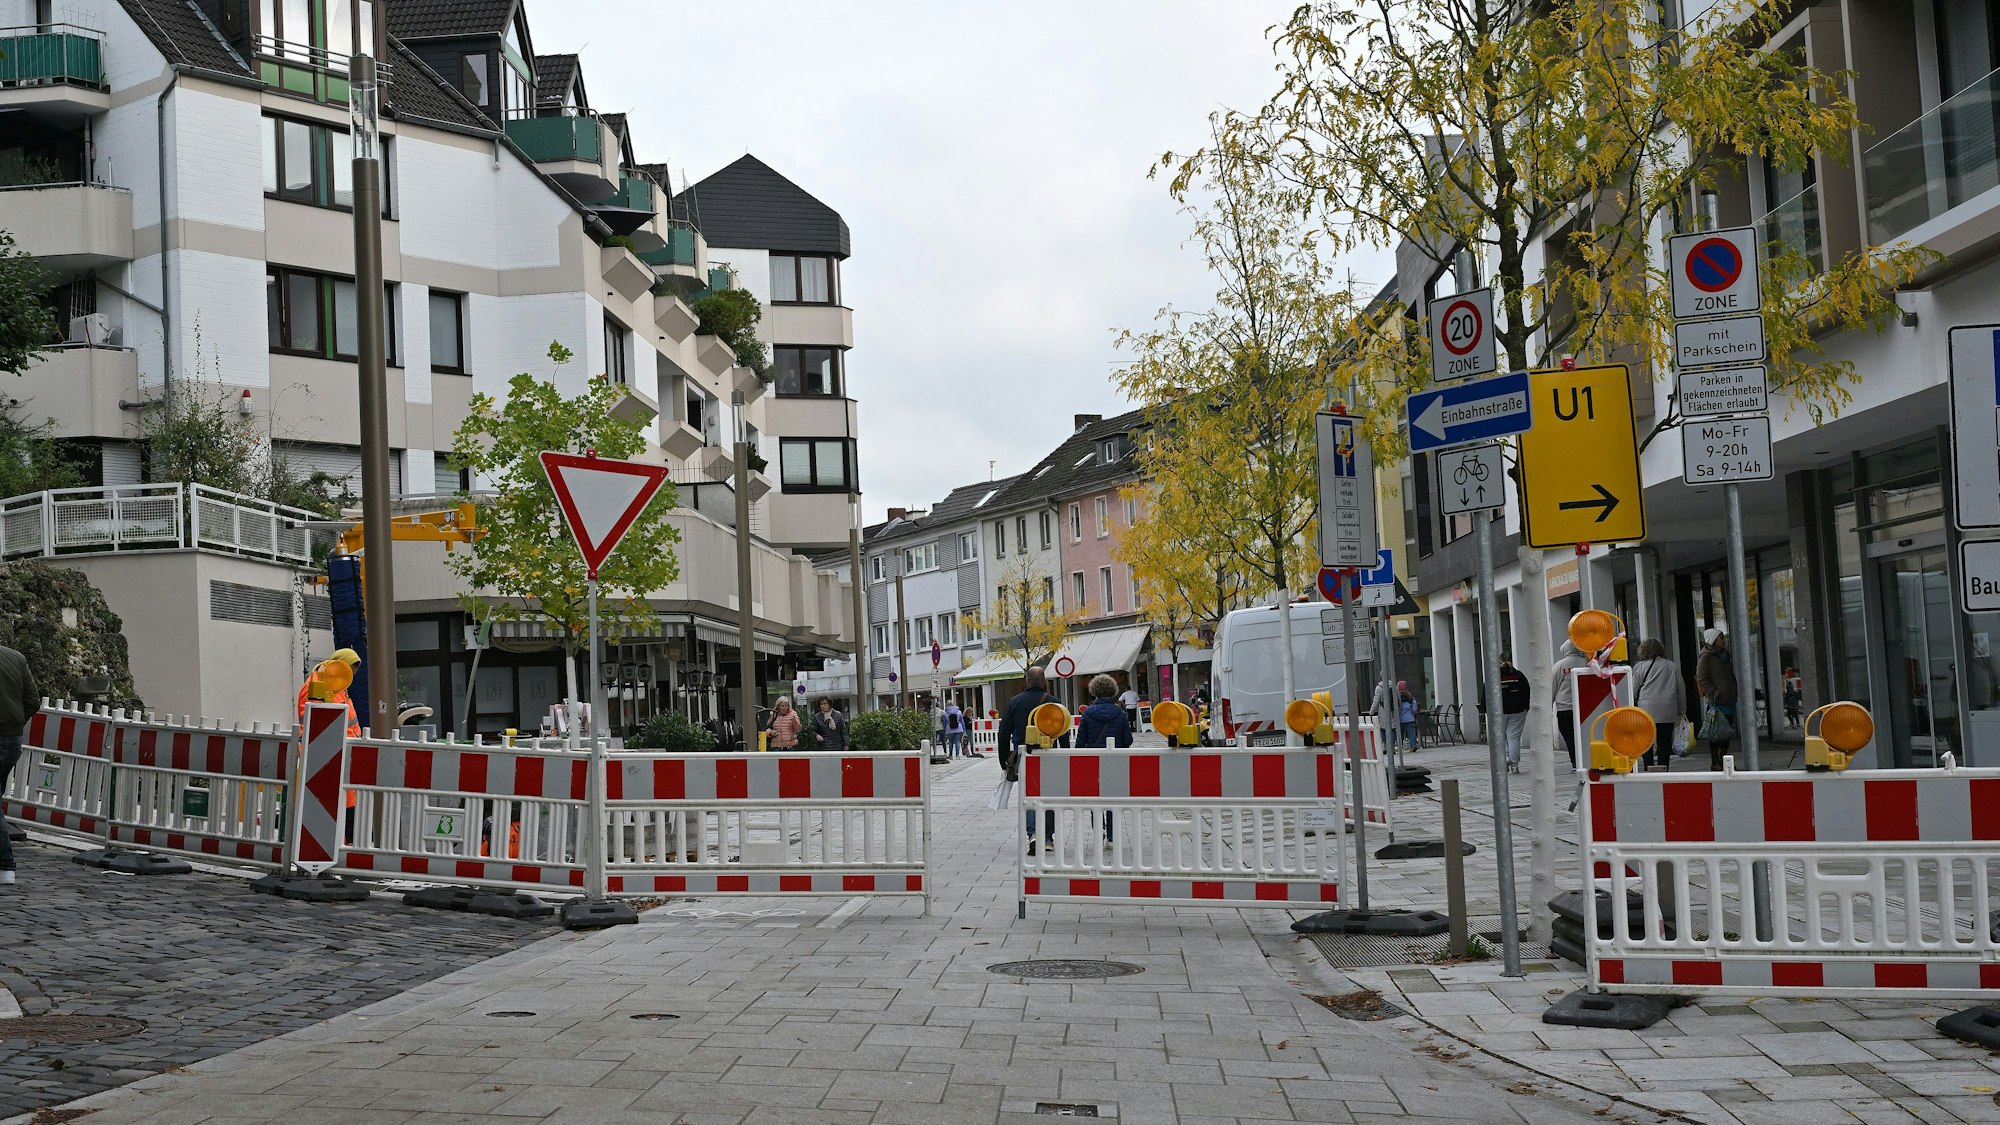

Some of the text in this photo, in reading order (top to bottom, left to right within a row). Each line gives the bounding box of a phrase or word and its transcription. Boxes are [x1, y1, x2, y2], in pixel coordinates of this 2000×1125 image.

[1694, 294, 1738, 311] ZONE
[1450, 313, 1474, 342] 20
[1708, 328, 1729, 341] mit
[1683, 340, 1757, 358] Parkschein
[1448, 355, 1481, 375] ZONE
[1700, 373, 1744, 386] Parken in
[1683, 385, 1763, 402] gekennzeichneten
[1441, 397, 1523, 424] Einbahnstraße
[1552, 385, 1595, 422] U1
[1688, 397, 1759, 412] Flächen erlaubt
[1702, 425, 1749, 440] Mo-Fr
[1706, 443, 1748, 458] 9-20h
[1696, 460, 1761, 477] Sa 9-14h
[1395, 641, 1413, 655] 20
